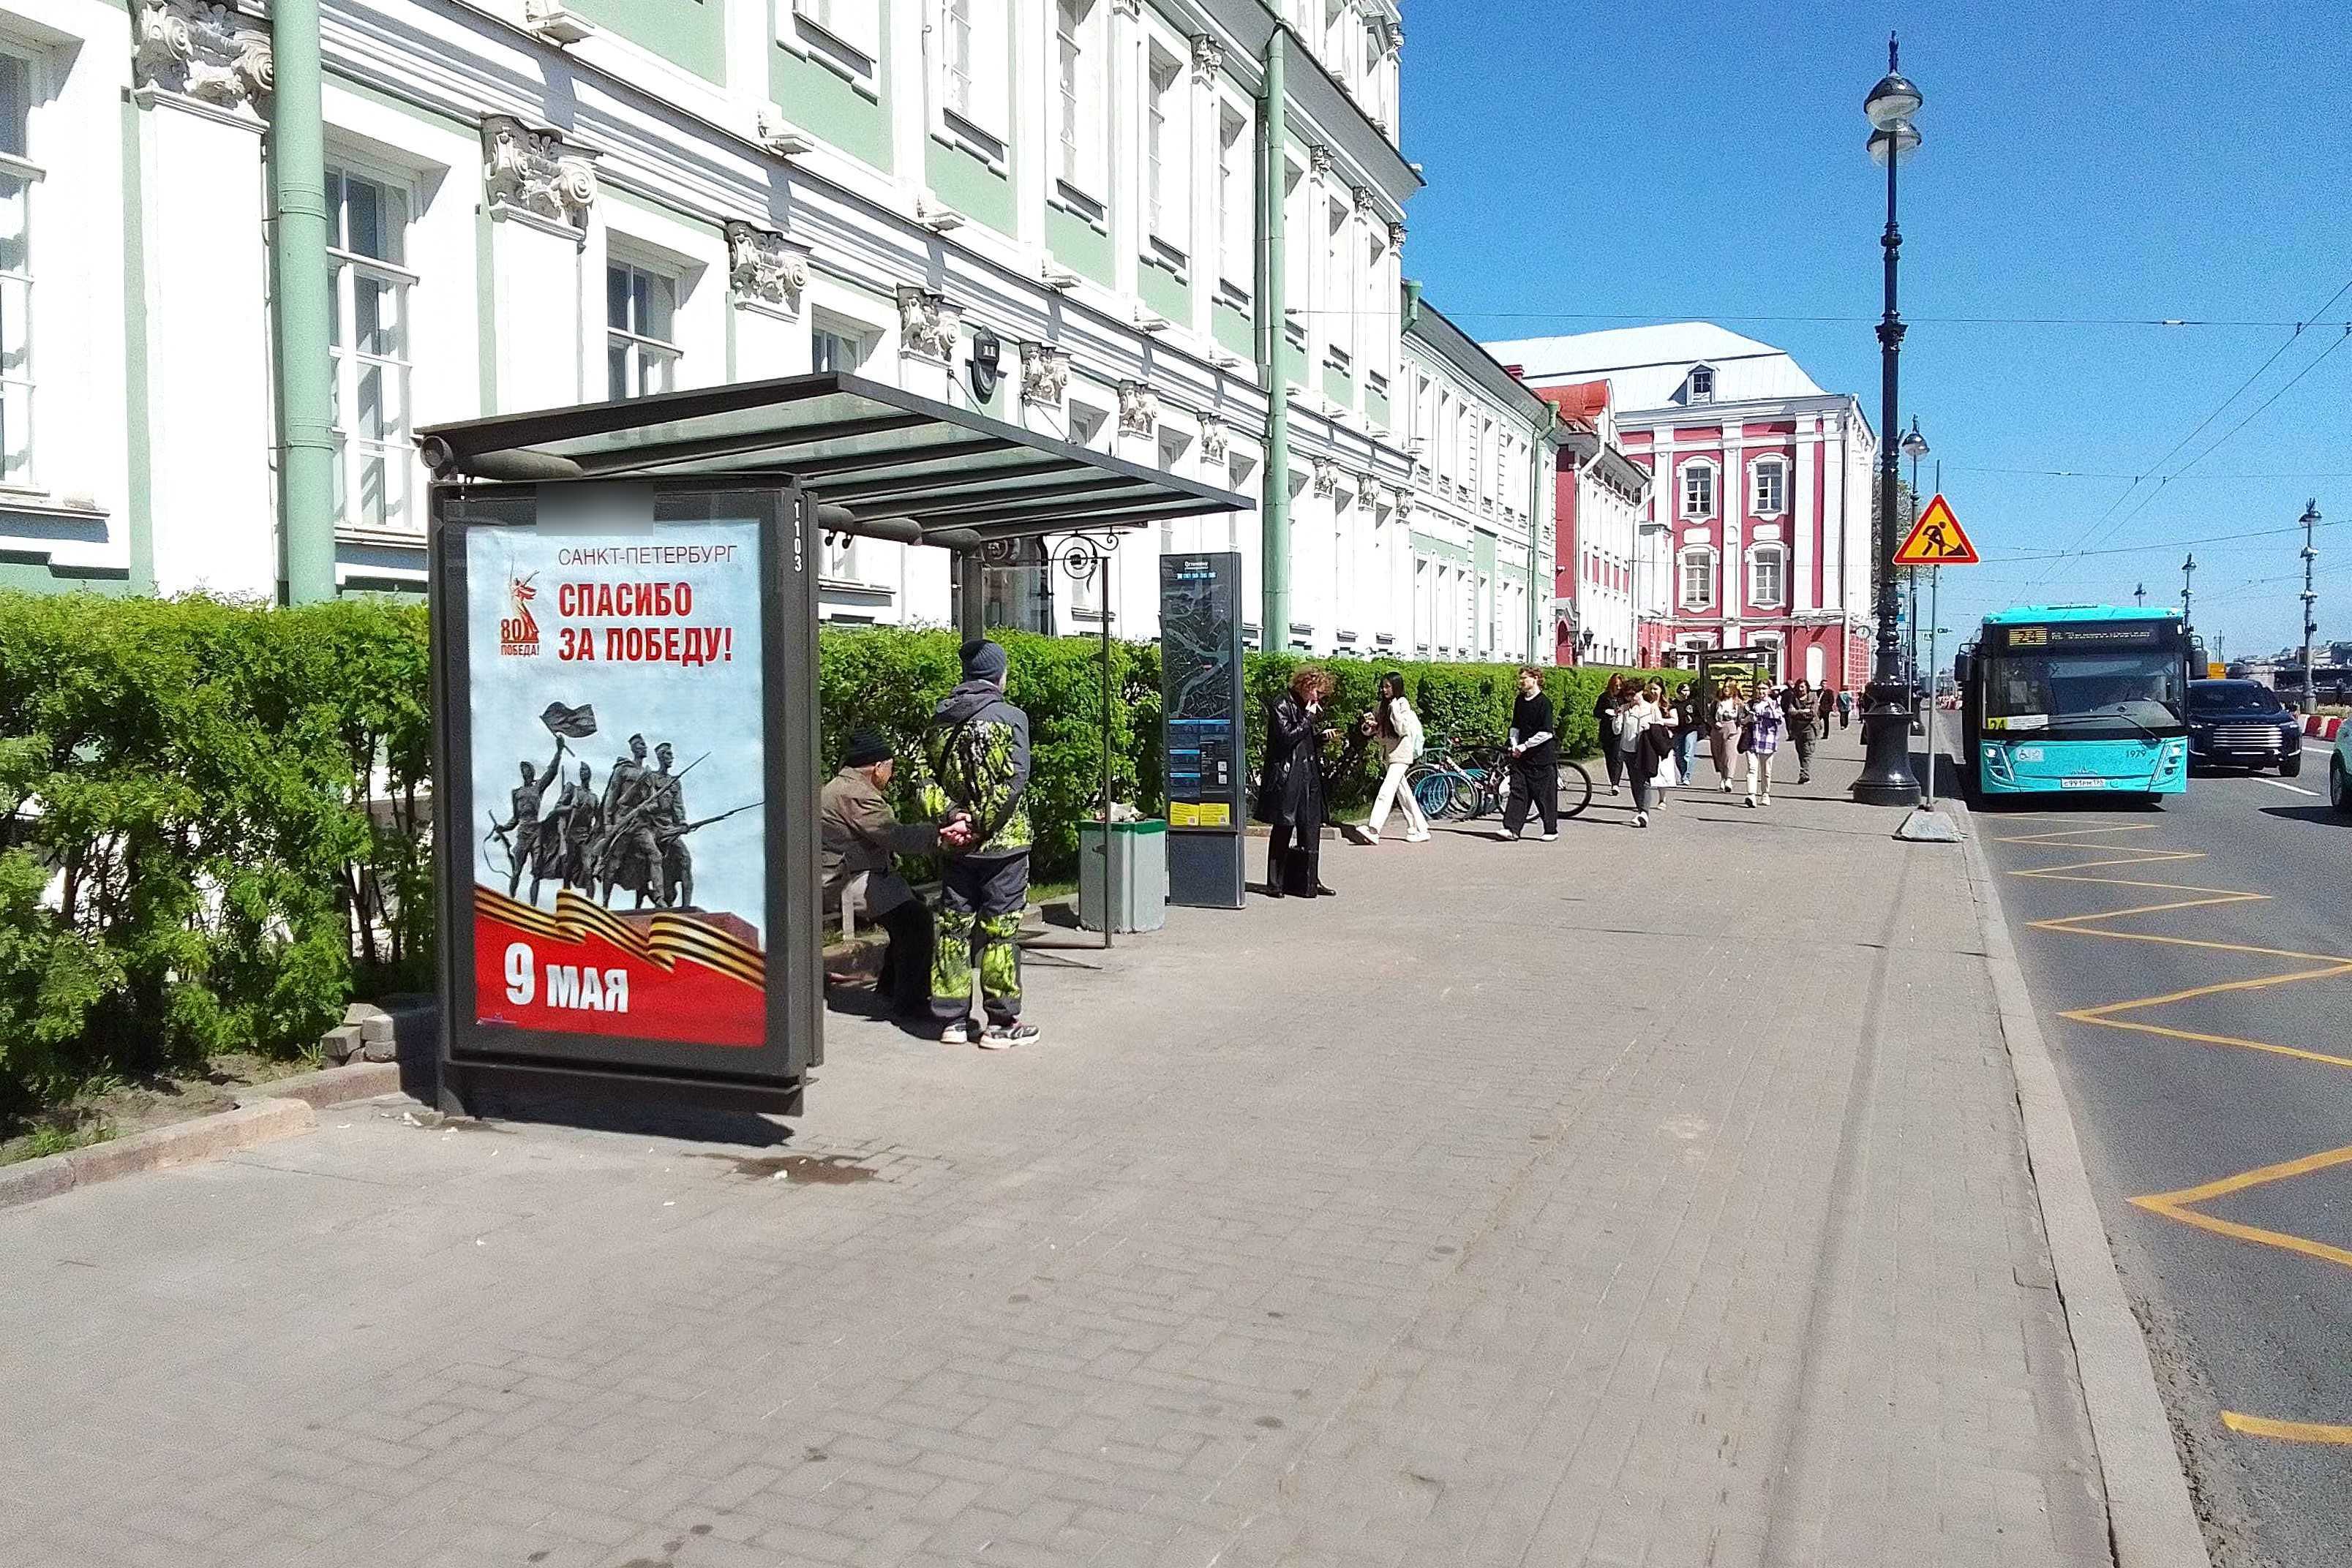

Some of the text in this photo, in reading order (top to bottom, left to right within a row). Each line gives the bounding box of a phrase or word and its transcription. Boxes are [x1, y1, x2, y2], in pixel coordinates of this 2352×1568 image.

[794, 501, 803, 572] 1103
[558, 546, 737, 565] САНКТ-ПЕТЕРБУРГ
[558, 582, 692, 617] СПАСИБО
[500, 619, 522, 641] 80
[558, 627, 732, 667] ЗА ПОБЕДУ!
[500, 644, 539, 657] ПОБЕДА!
[504, 942, 630, 1013] 9 МАЯ
